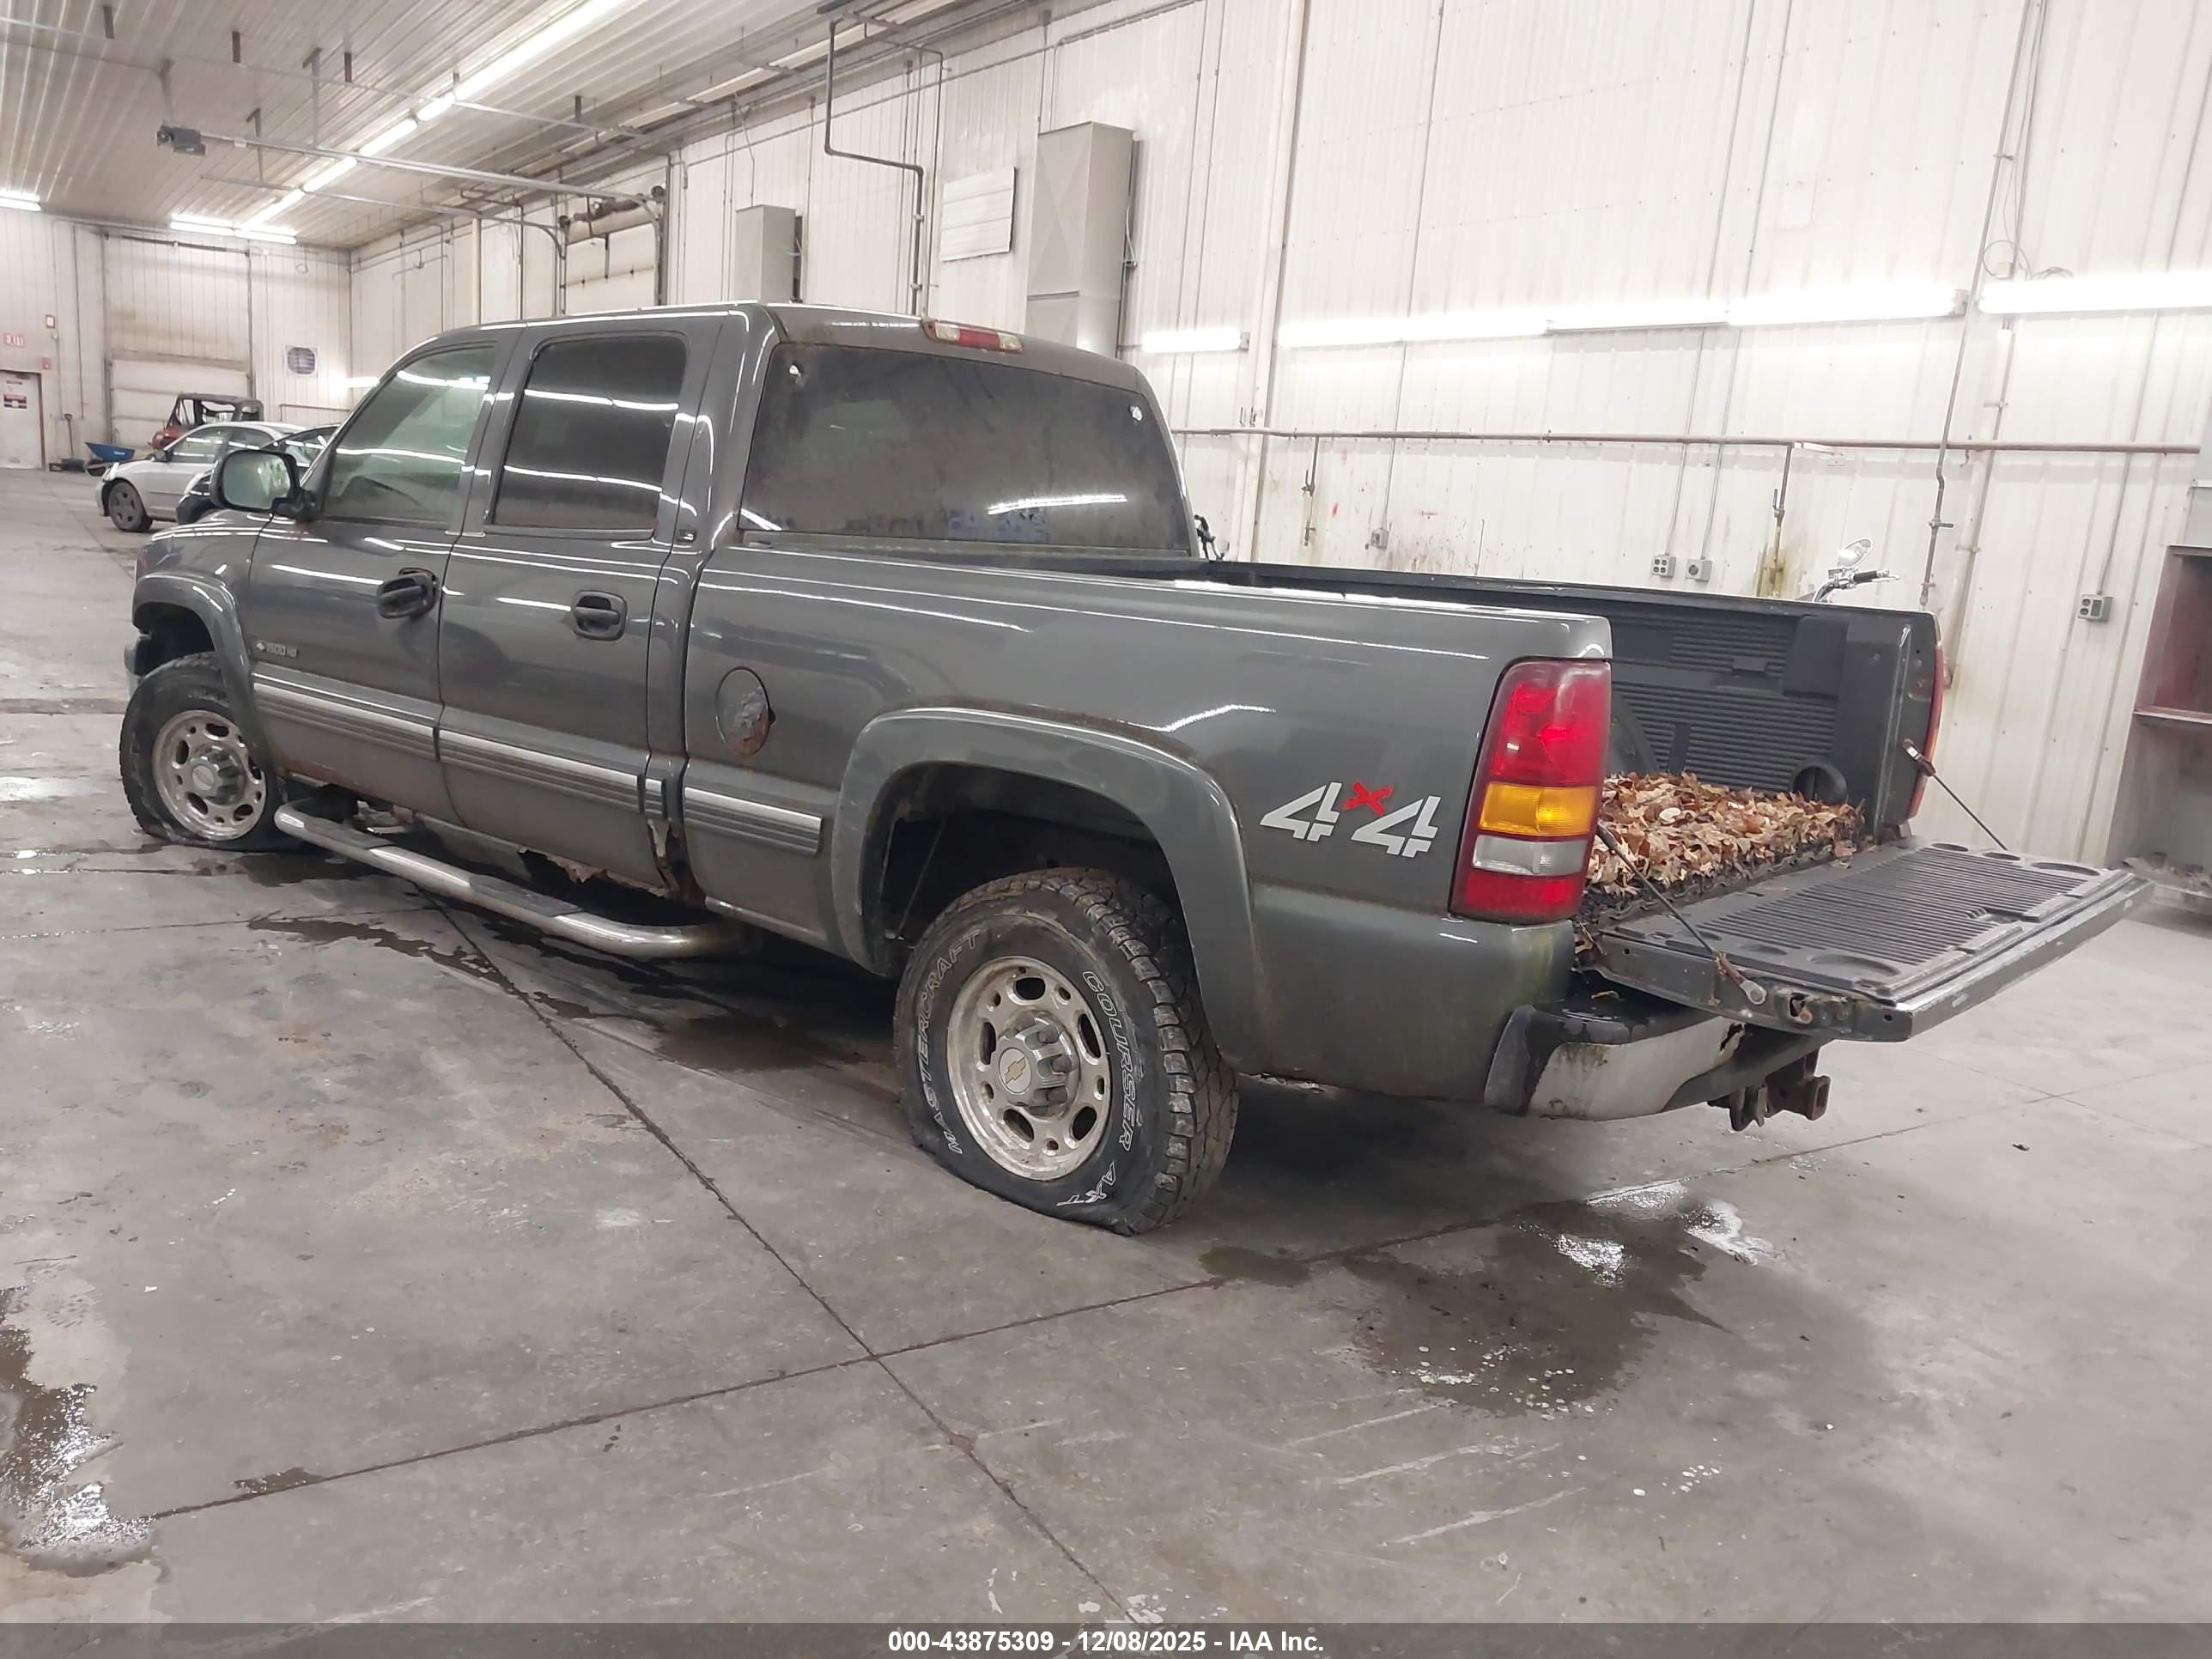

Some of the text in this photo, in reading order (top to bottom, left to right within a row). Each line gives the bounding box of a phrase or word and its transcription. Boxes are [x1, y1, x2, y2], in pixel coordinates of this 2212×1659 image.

[918, 929, 981, 1155] MASTERCRAFT
[1082, 970, 1136, 1152] COURSER
[1055, 1160, 1117, 1206] AXT
